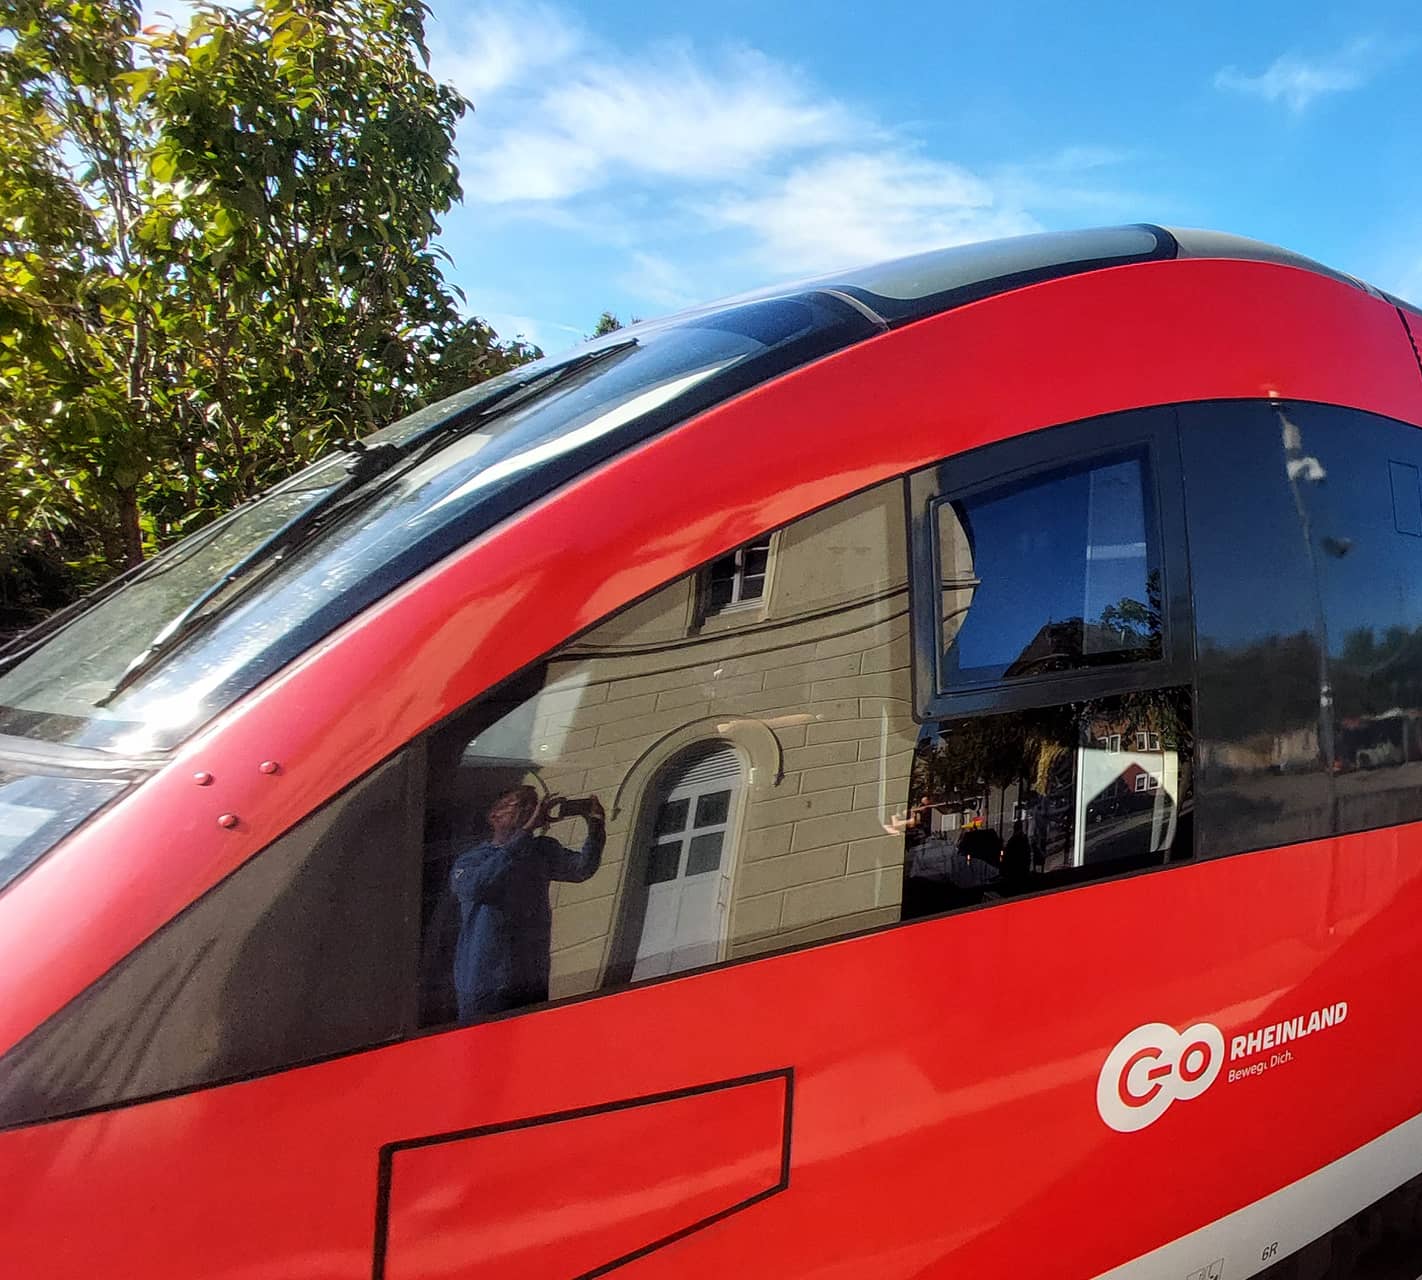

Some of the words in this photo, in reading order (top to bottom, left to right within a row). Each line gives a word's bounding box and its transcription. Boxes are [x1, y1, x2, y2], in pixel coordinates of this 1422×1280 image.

[1230, 1001, 1348, 1061] RHEINLAND
[1270, 1049, 1294, 1068] Dich.
[1261, 1241, 1279, 1261] 6R
